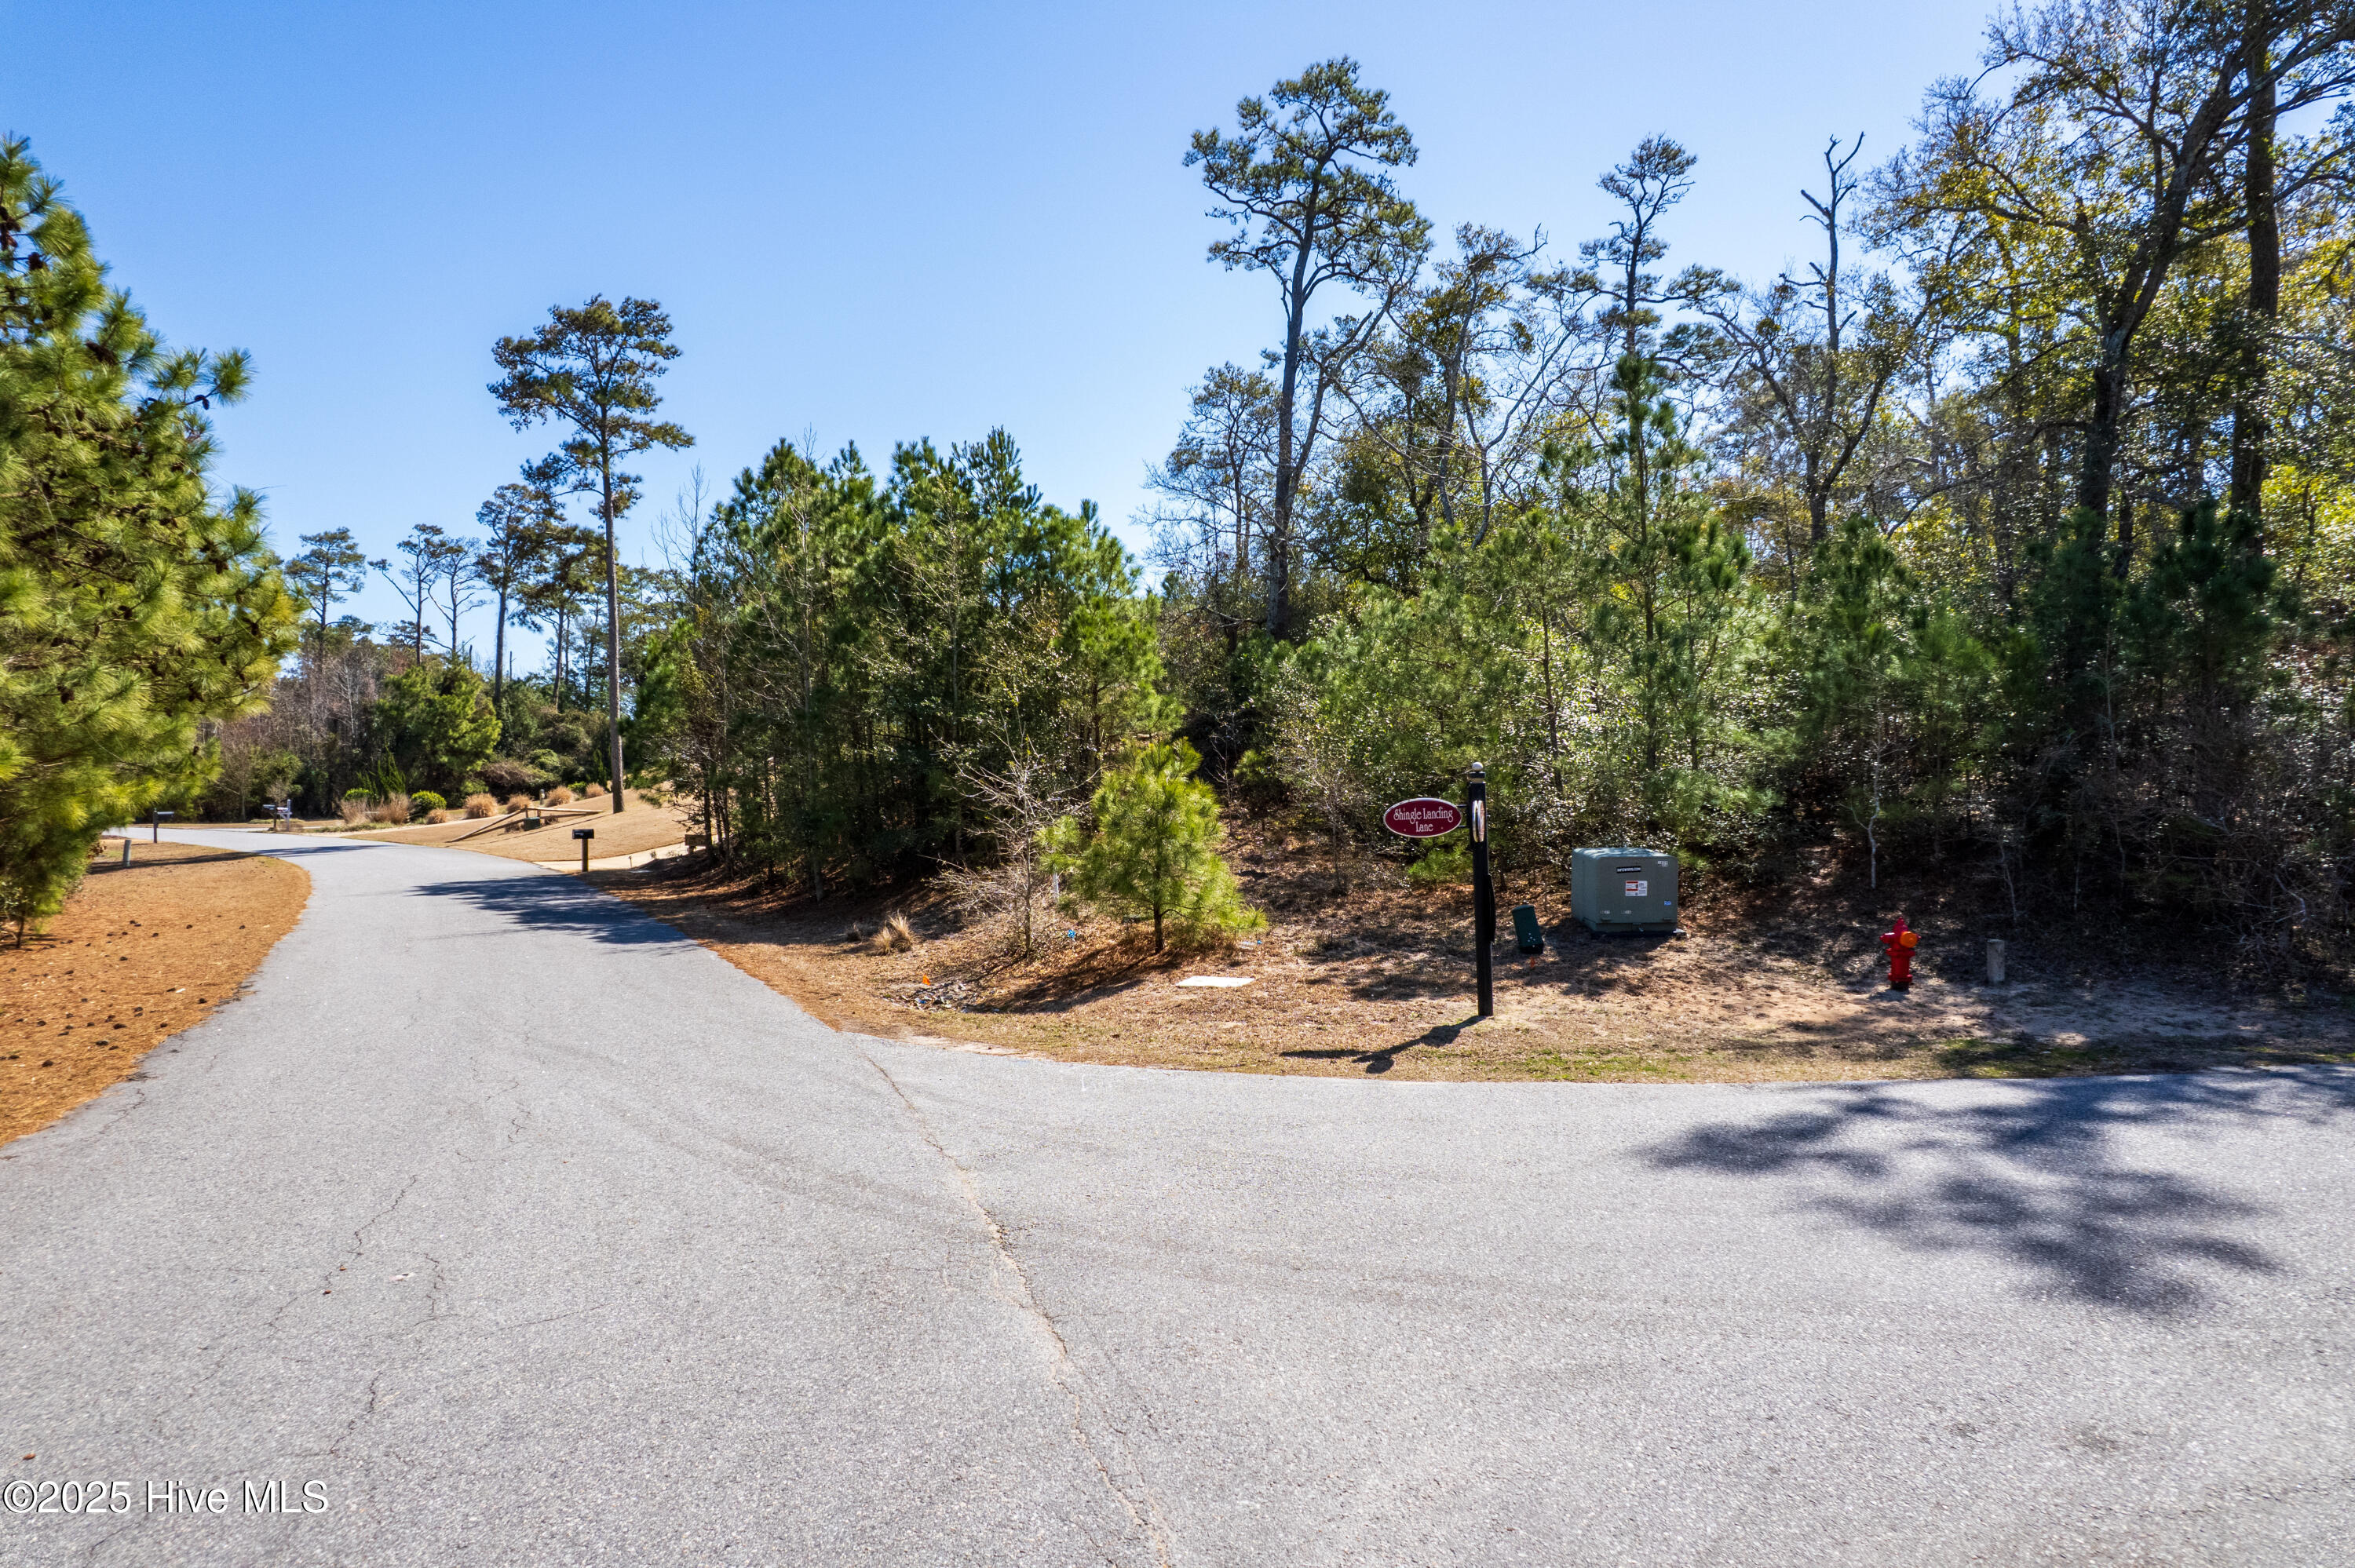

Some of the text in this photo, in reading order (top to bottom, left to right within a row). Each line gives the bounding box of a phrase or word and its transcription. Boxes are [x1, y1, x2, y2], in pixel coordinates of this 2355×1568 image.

[1393, 806, 1453, 824] Shingle Landing
[1415, 821, 1433, 832] Lane
